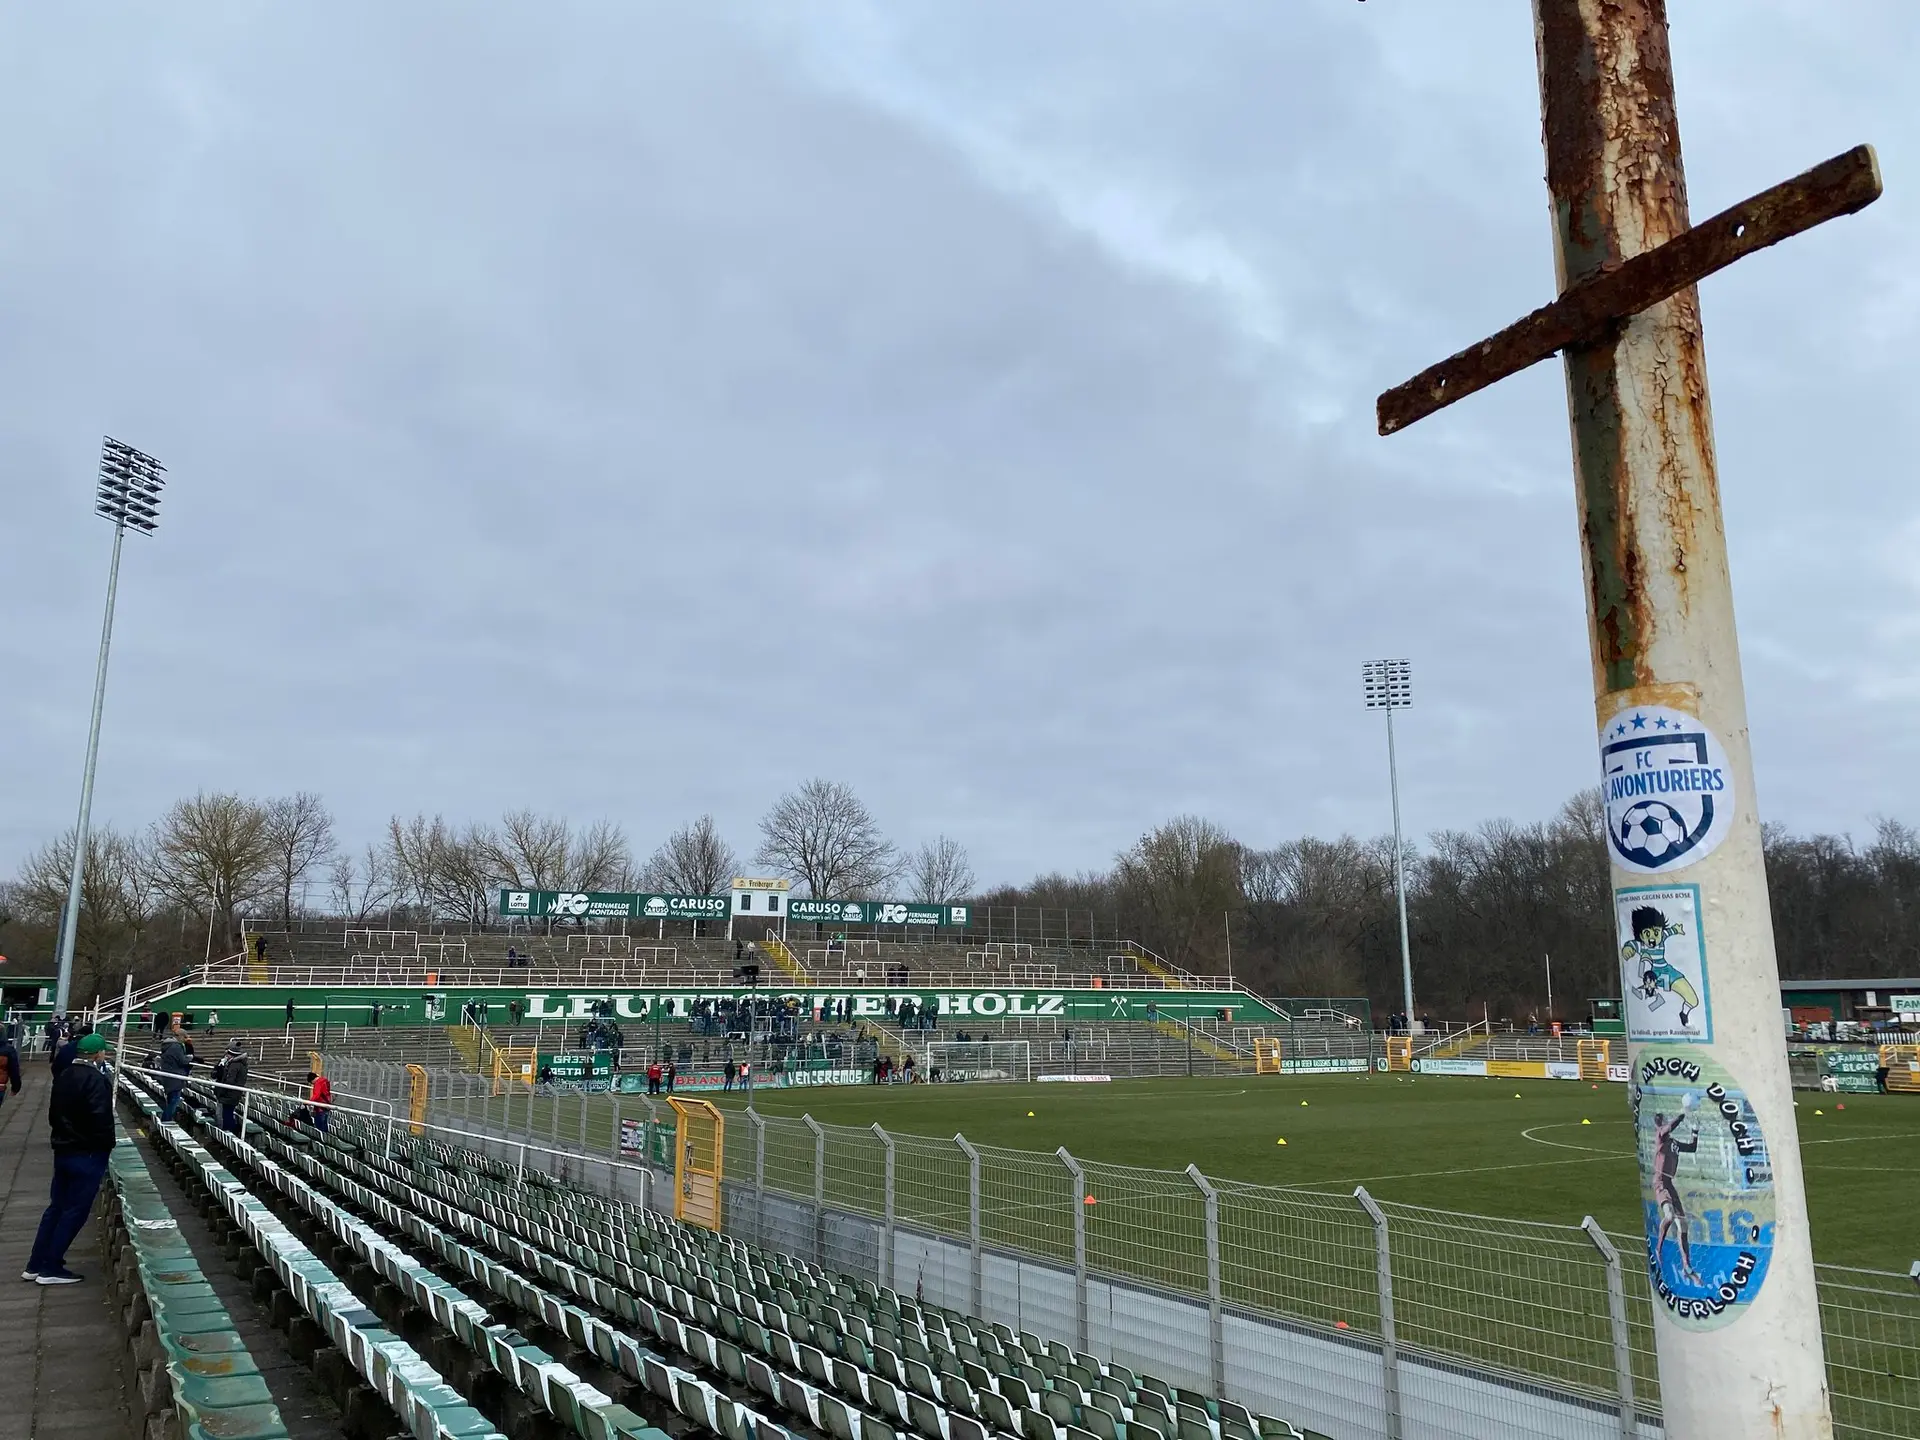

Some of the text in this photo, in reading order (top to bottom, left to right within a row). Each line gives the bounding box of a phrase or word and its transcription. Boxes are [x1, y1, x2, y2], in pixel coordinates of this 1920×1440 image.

[1635, 750, 1653, 770] FC
[1611, 768, 1725, 801] AVONTURIERS
[590, 902, 630, 910] FERNMELDE
[670, 898, 725, 910] CARUSO
[791, 902, 841, 914] CARUSO
[935, 994, 1064, 1015] HOLZ
[1837, 1054, 1880, 1062] FAMILIEN
[1642, 1059, 1700, 1082] MICH
[1842, 1063, 1879, 1072] BLOCK
[788, 1069, 862, 1085] VENCEREMOS
